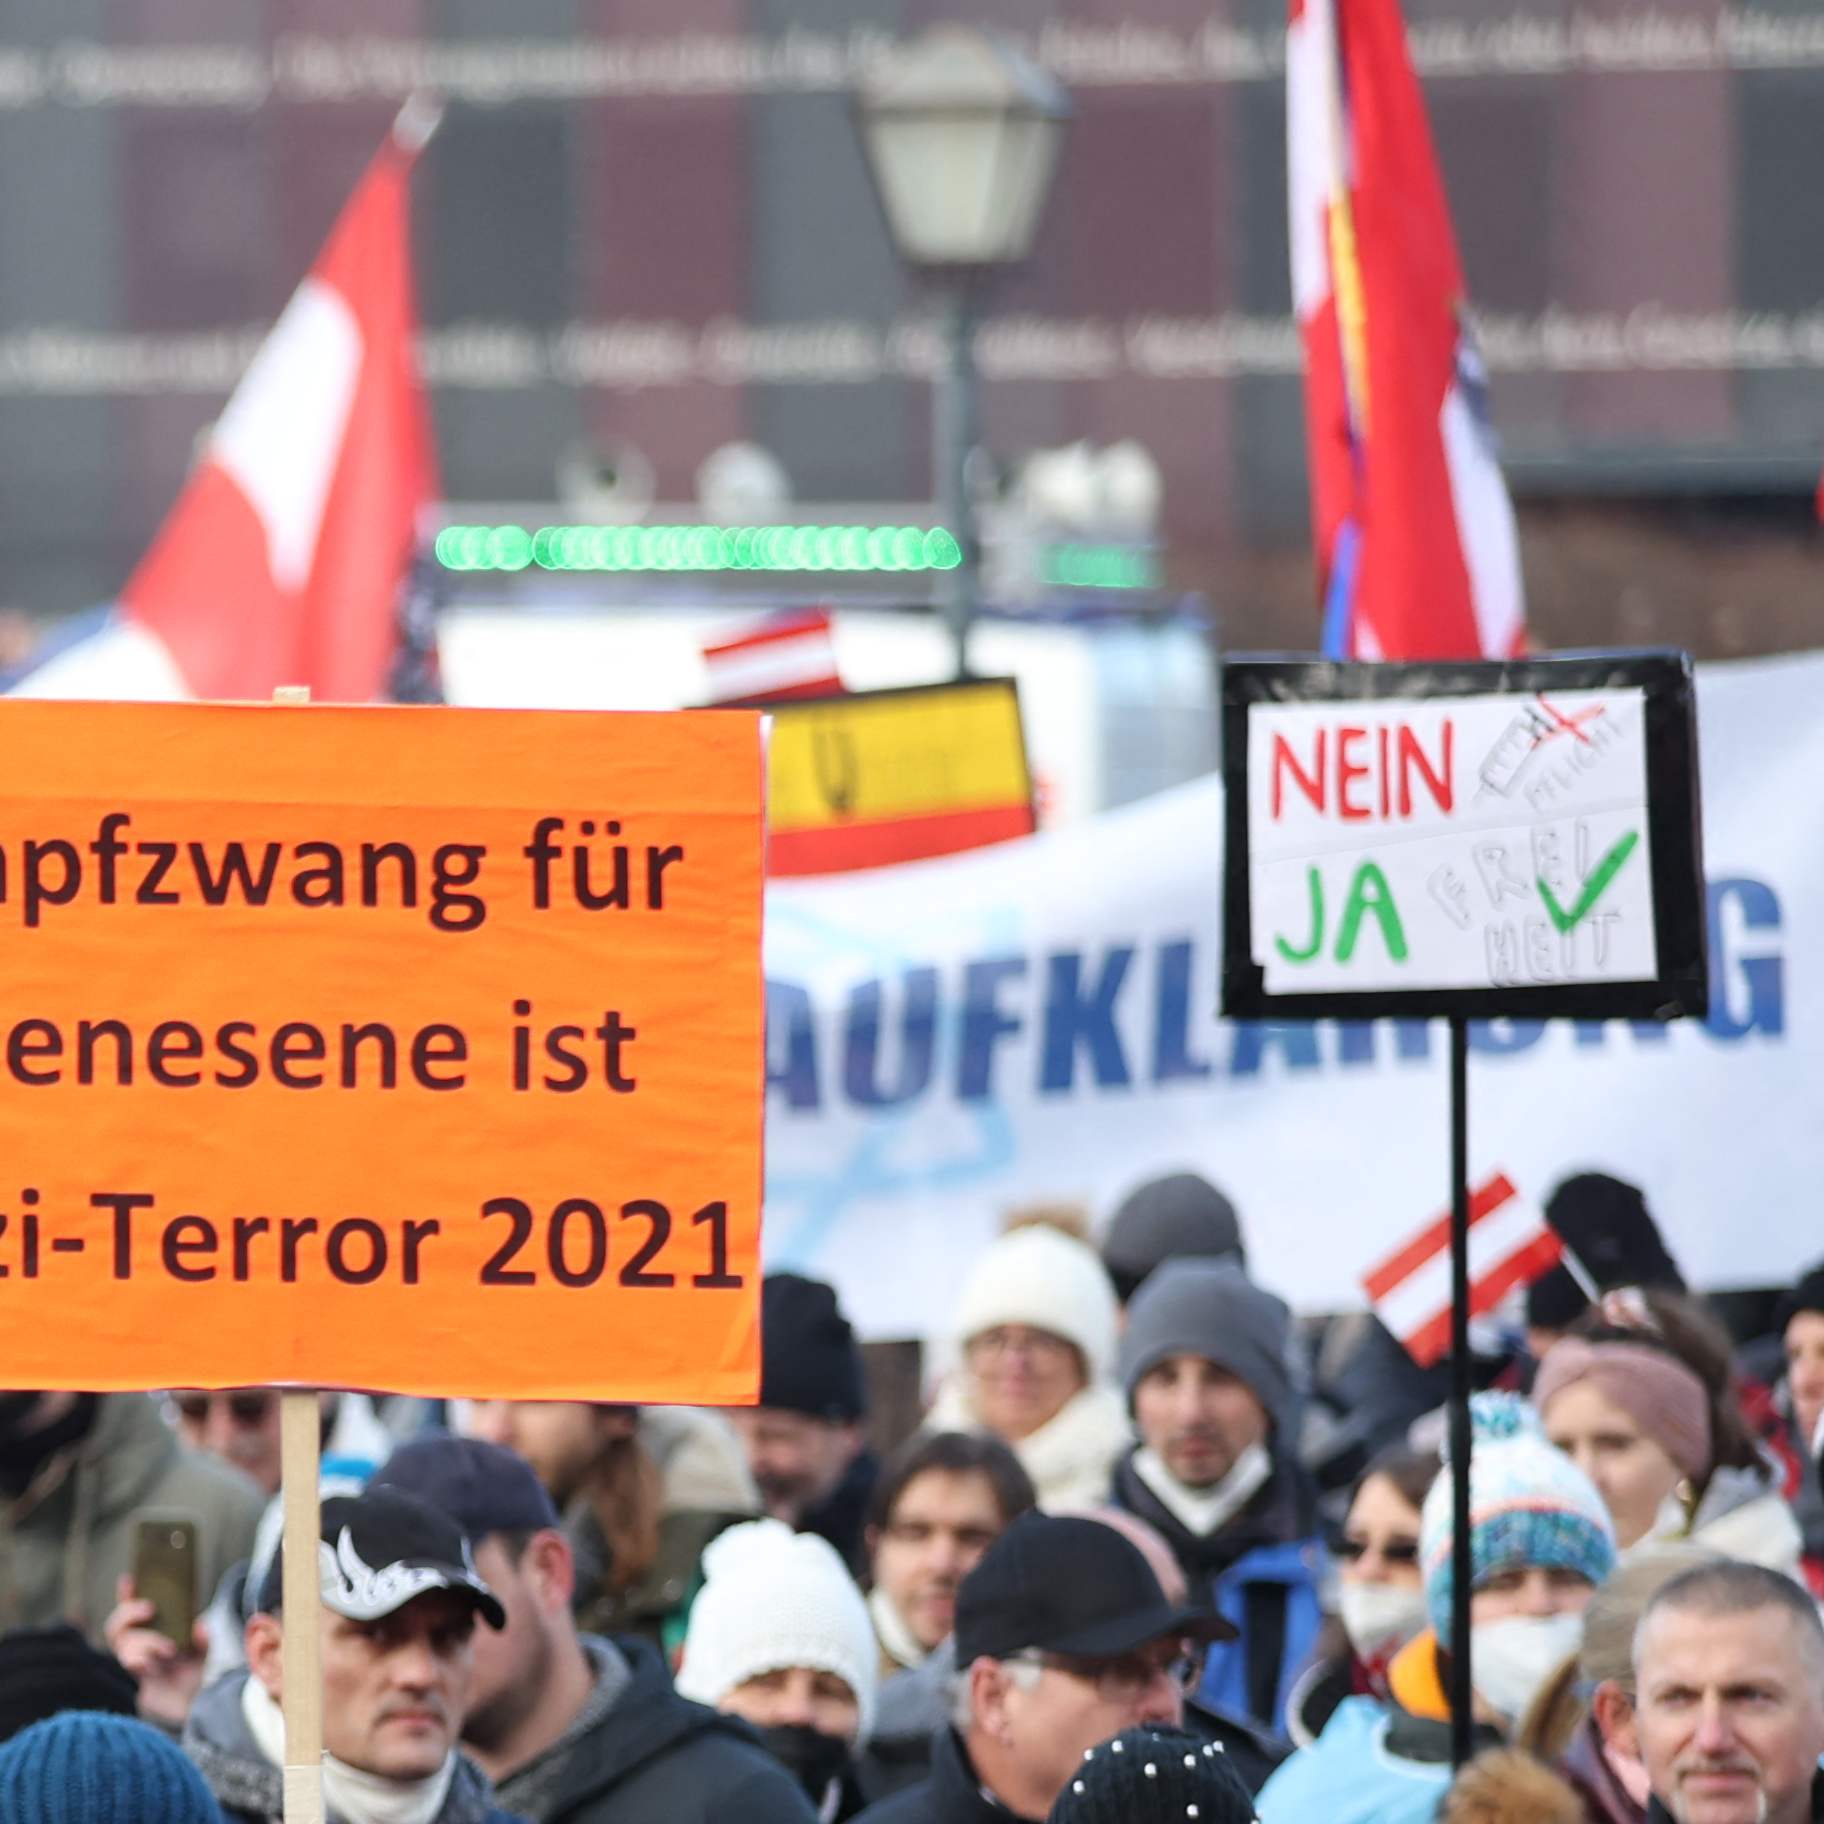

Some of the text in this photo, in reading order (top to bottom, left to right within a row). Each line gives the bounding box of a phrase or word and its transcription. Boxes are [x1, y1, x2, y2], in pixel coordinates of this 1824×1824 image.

[1272, 717, 1455, 824] NEIN
[524, 818, 684, 911] für
[1275, 860, 1409, 964] JA
[764, 876, 1784, 1110] AUFKLG
[510, 999, 638, 1094] ist
[479, 1197, 744, 1290] 2021
